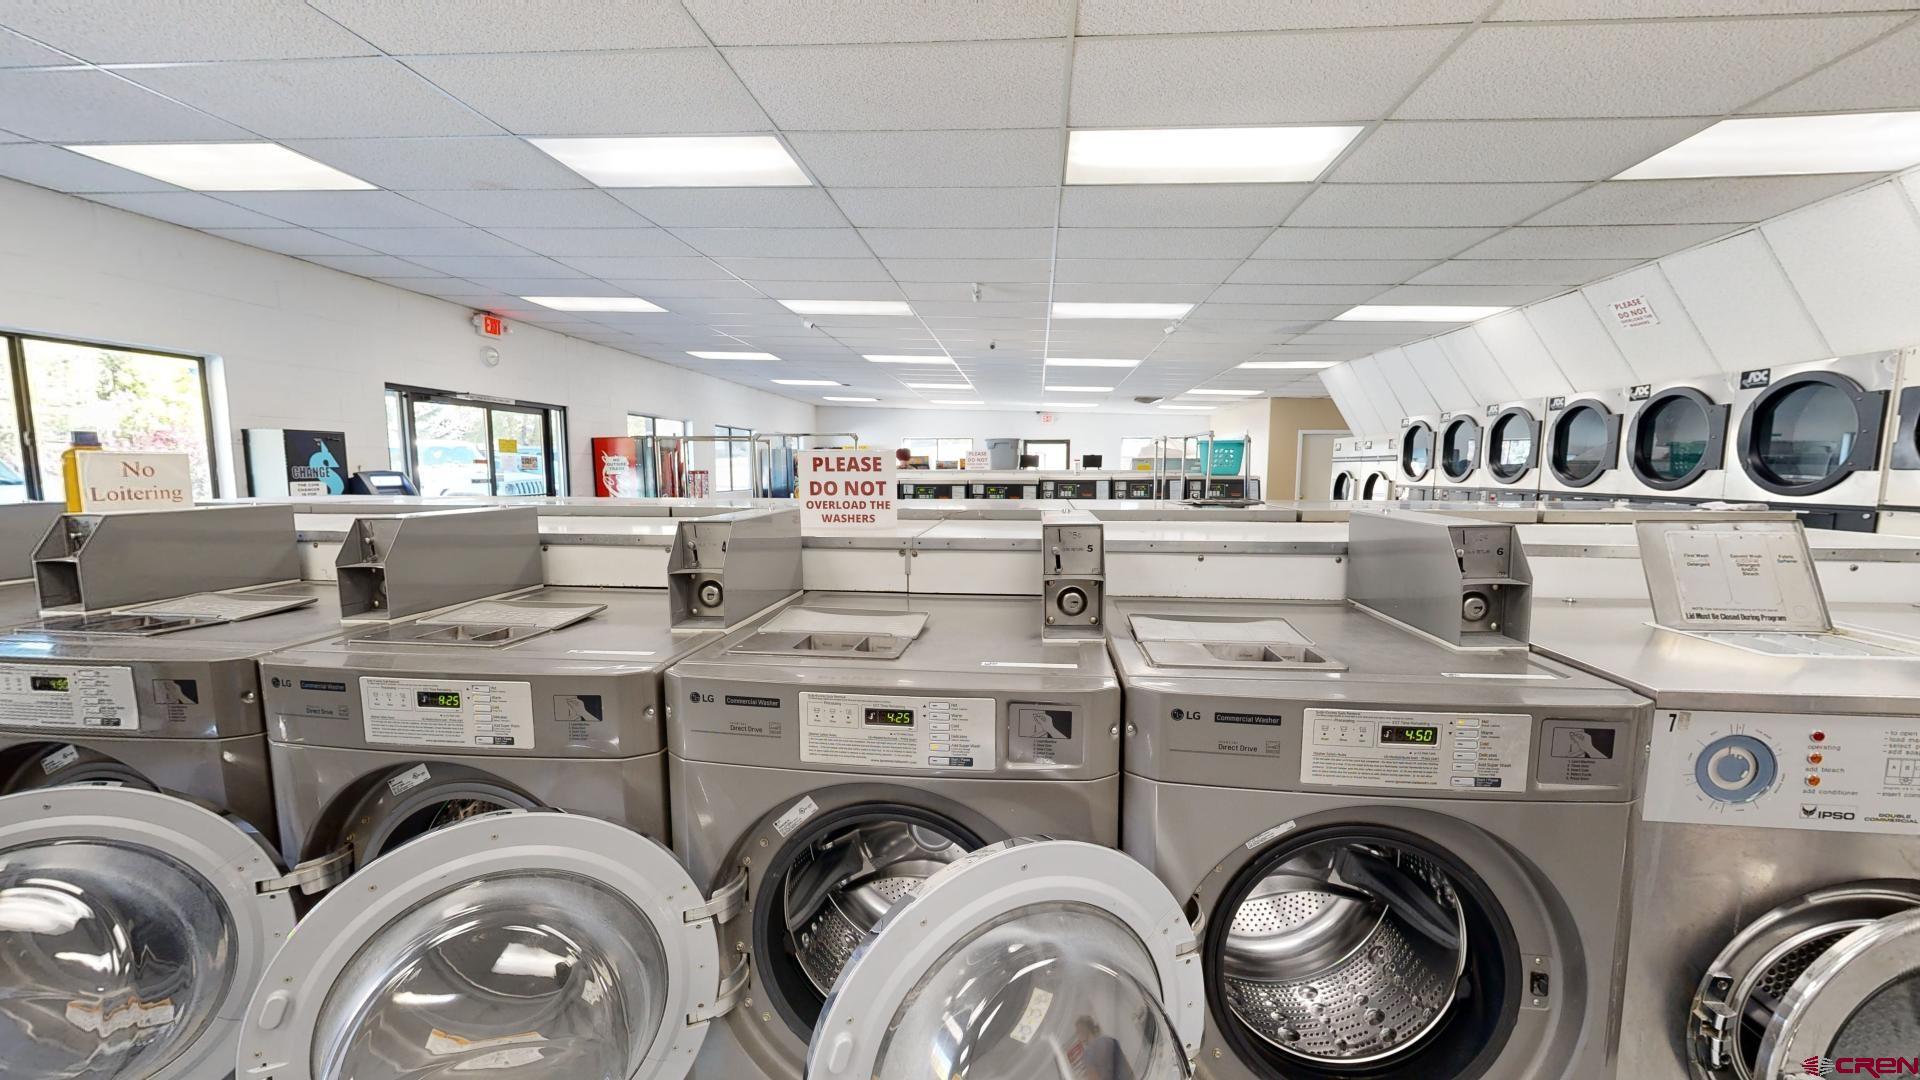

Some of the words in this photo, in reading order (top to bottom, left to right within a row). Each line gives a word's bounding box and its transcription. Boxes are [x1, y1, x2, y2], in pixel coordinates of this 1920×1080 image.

[1614, 298, 1642, 310] PLEASE
[1618, 311, 1630, 319] DO
[1630, 307, 1647, 316] NOT
[1748, 370, 1768, 383] ADC
[121, 461, 155, 478] No
[812, 456, 882, 473] PLEASE
[291, 465, 330, 479] CHANGE
[809, 480, 838, 496] DO
[844, 480, 886, 496] NOT
[90, 485, 183, 502] Loitering
[806, 500, 867, 510] OVERLOAD
[869, 500, 891, 510] THE
[821, 514, 876, 523] WASHERS
[1086, 544, 1094, 553] 5
[1496, 547, 1504, 556] 6
[1740, 613, 1760, 621] During
[1761, 614, 1787, 622] Program
[281, 680, 292, 688] LG
[702, 694, 715, 702] LG
[726, 697, 757, 705] Commercial
[758, 698, 779, 707] Washer
[887, 712, 910, 724] 4.25
[1186, 711, 1201, 721] LG
[1216, 714, 1253, 723] Commercial
[1254, 716, 1280, 725] Washer
[1668, 713, 1677, 732] 7
[748, 725, 763, 733] Drive
[1405, 729, 1433, 742] 4.50
[1218, 743, 1238, 751] Direct
[1818, 811, 1856, 820] IPSO
[1863, 816, 1919, 824] COMMERCIAL
